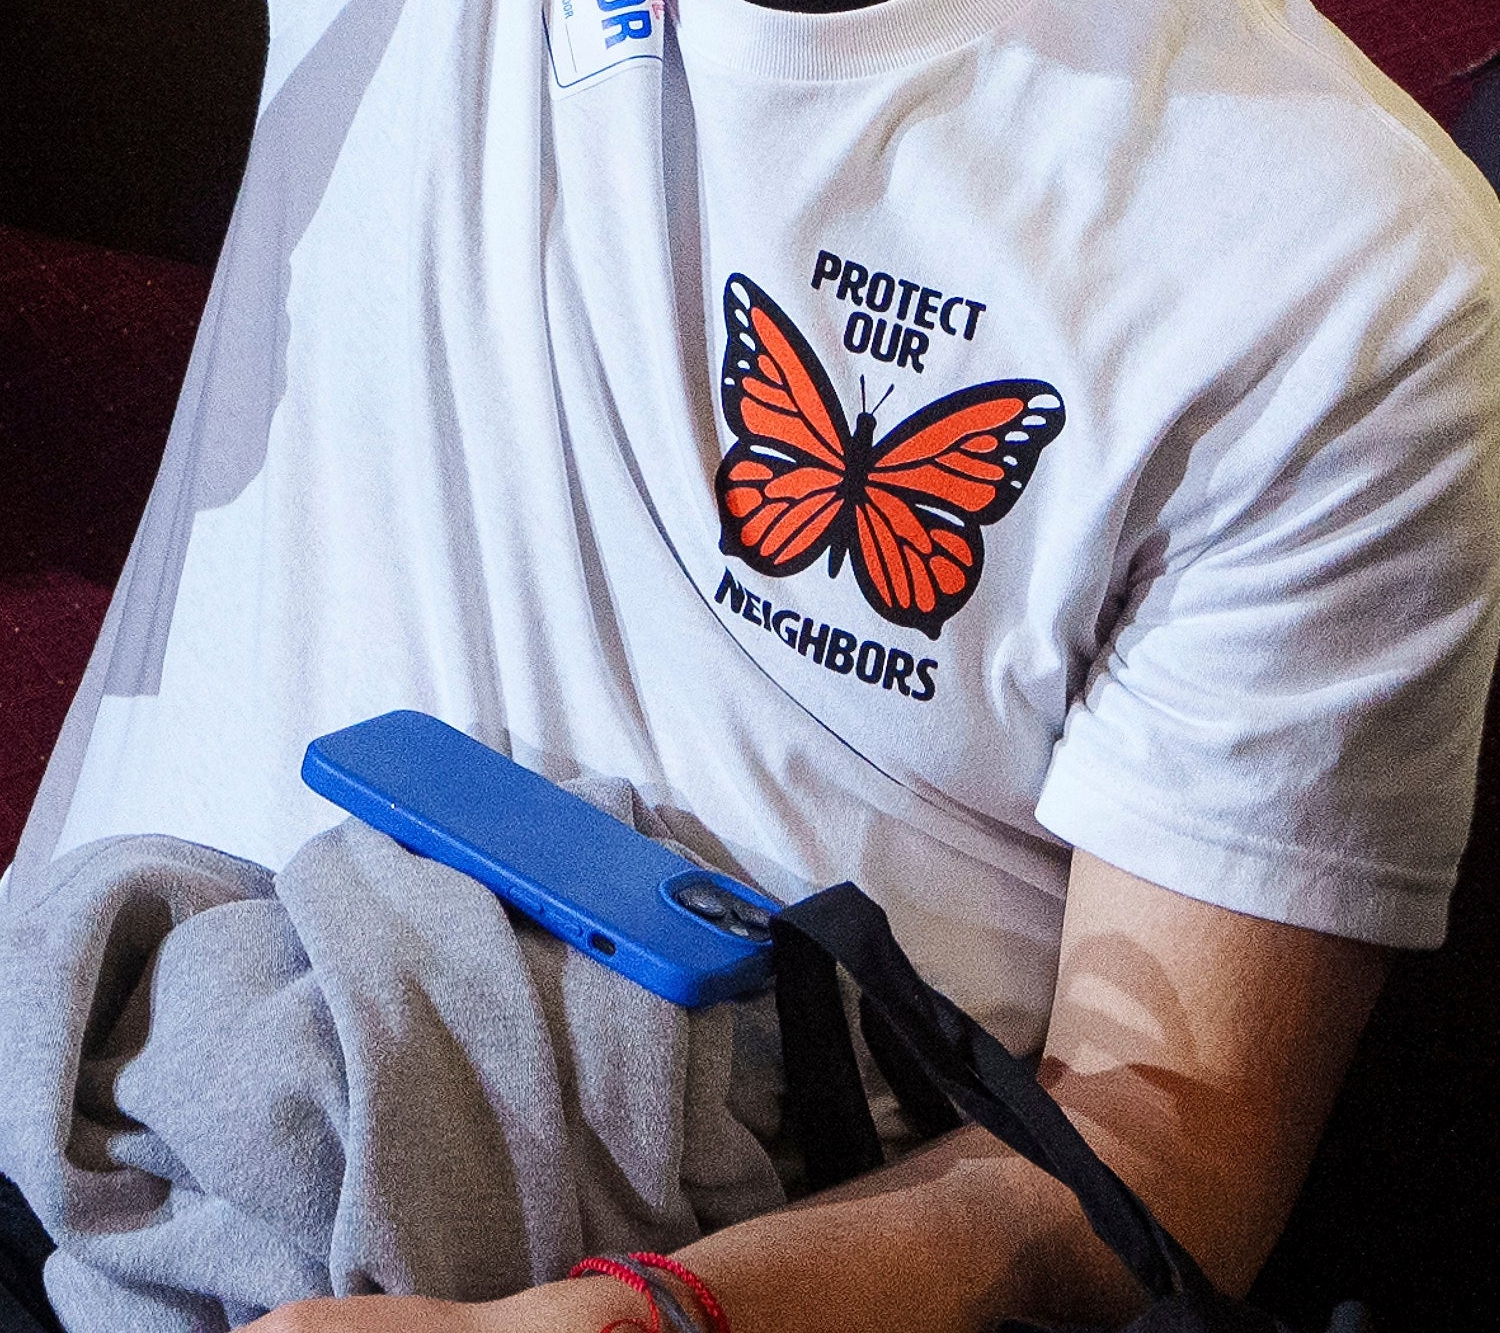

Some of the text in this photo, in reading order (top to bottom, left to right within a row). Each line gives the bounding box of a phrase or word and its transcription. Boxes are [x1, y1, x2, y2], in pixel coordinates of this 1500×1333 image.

[811, 249, 987, 342] PROTECT
[843, 311, 930, 374] OUR
[713, 565, 939, 702] NEIGHBORS
